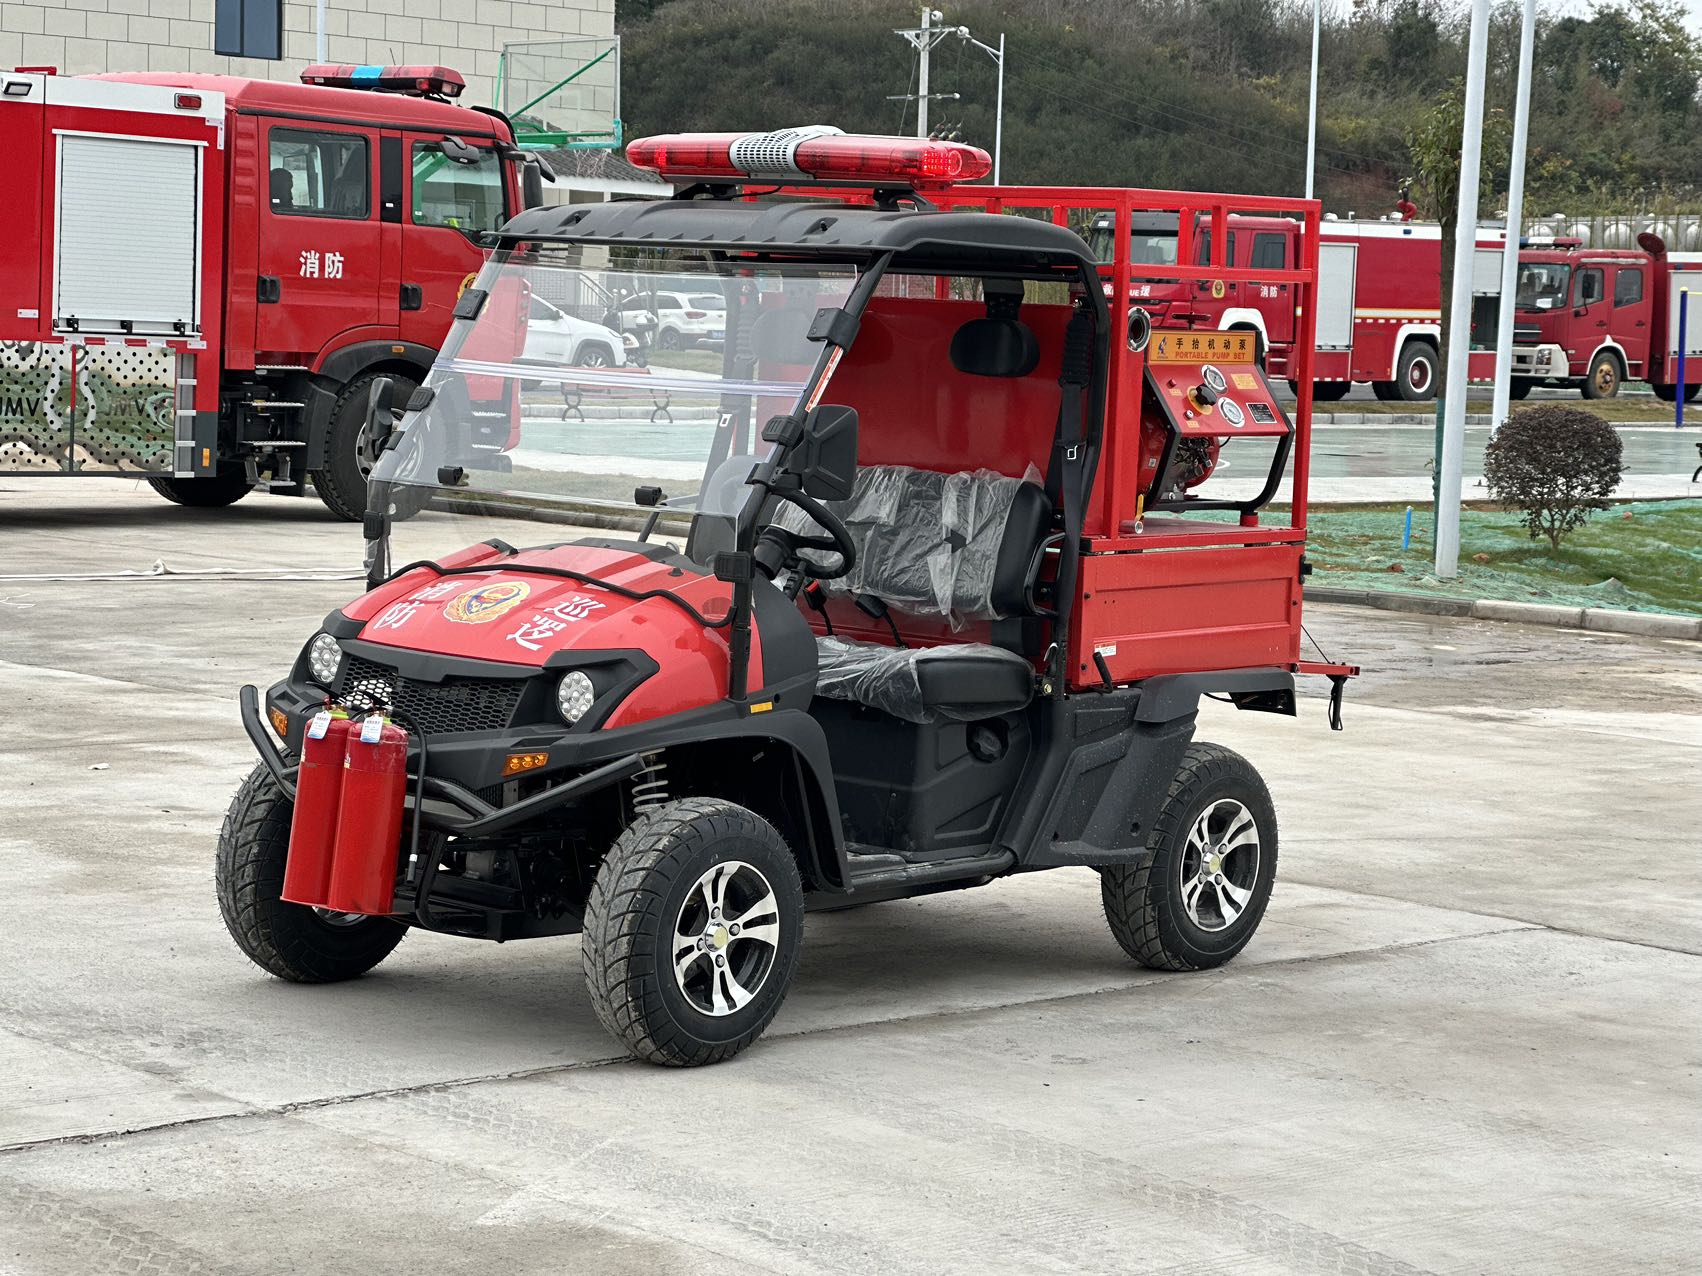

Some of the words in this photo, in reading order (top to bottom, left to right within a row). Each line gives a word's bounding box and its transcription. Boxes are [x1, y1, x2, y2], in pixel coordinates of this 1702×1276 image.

[299, 250, 344, 278] 消防
[1260, 285, 1278, 298] 消防
[1176, 337, 1246, 351] 手抬机动泵
[1175, 351, 1209, 360] PORTABLE
[1212, 352, 1231, 360] PUMP
[1233, 352, 1246, 360] SET
[373, 581, 463, 630] 消防
